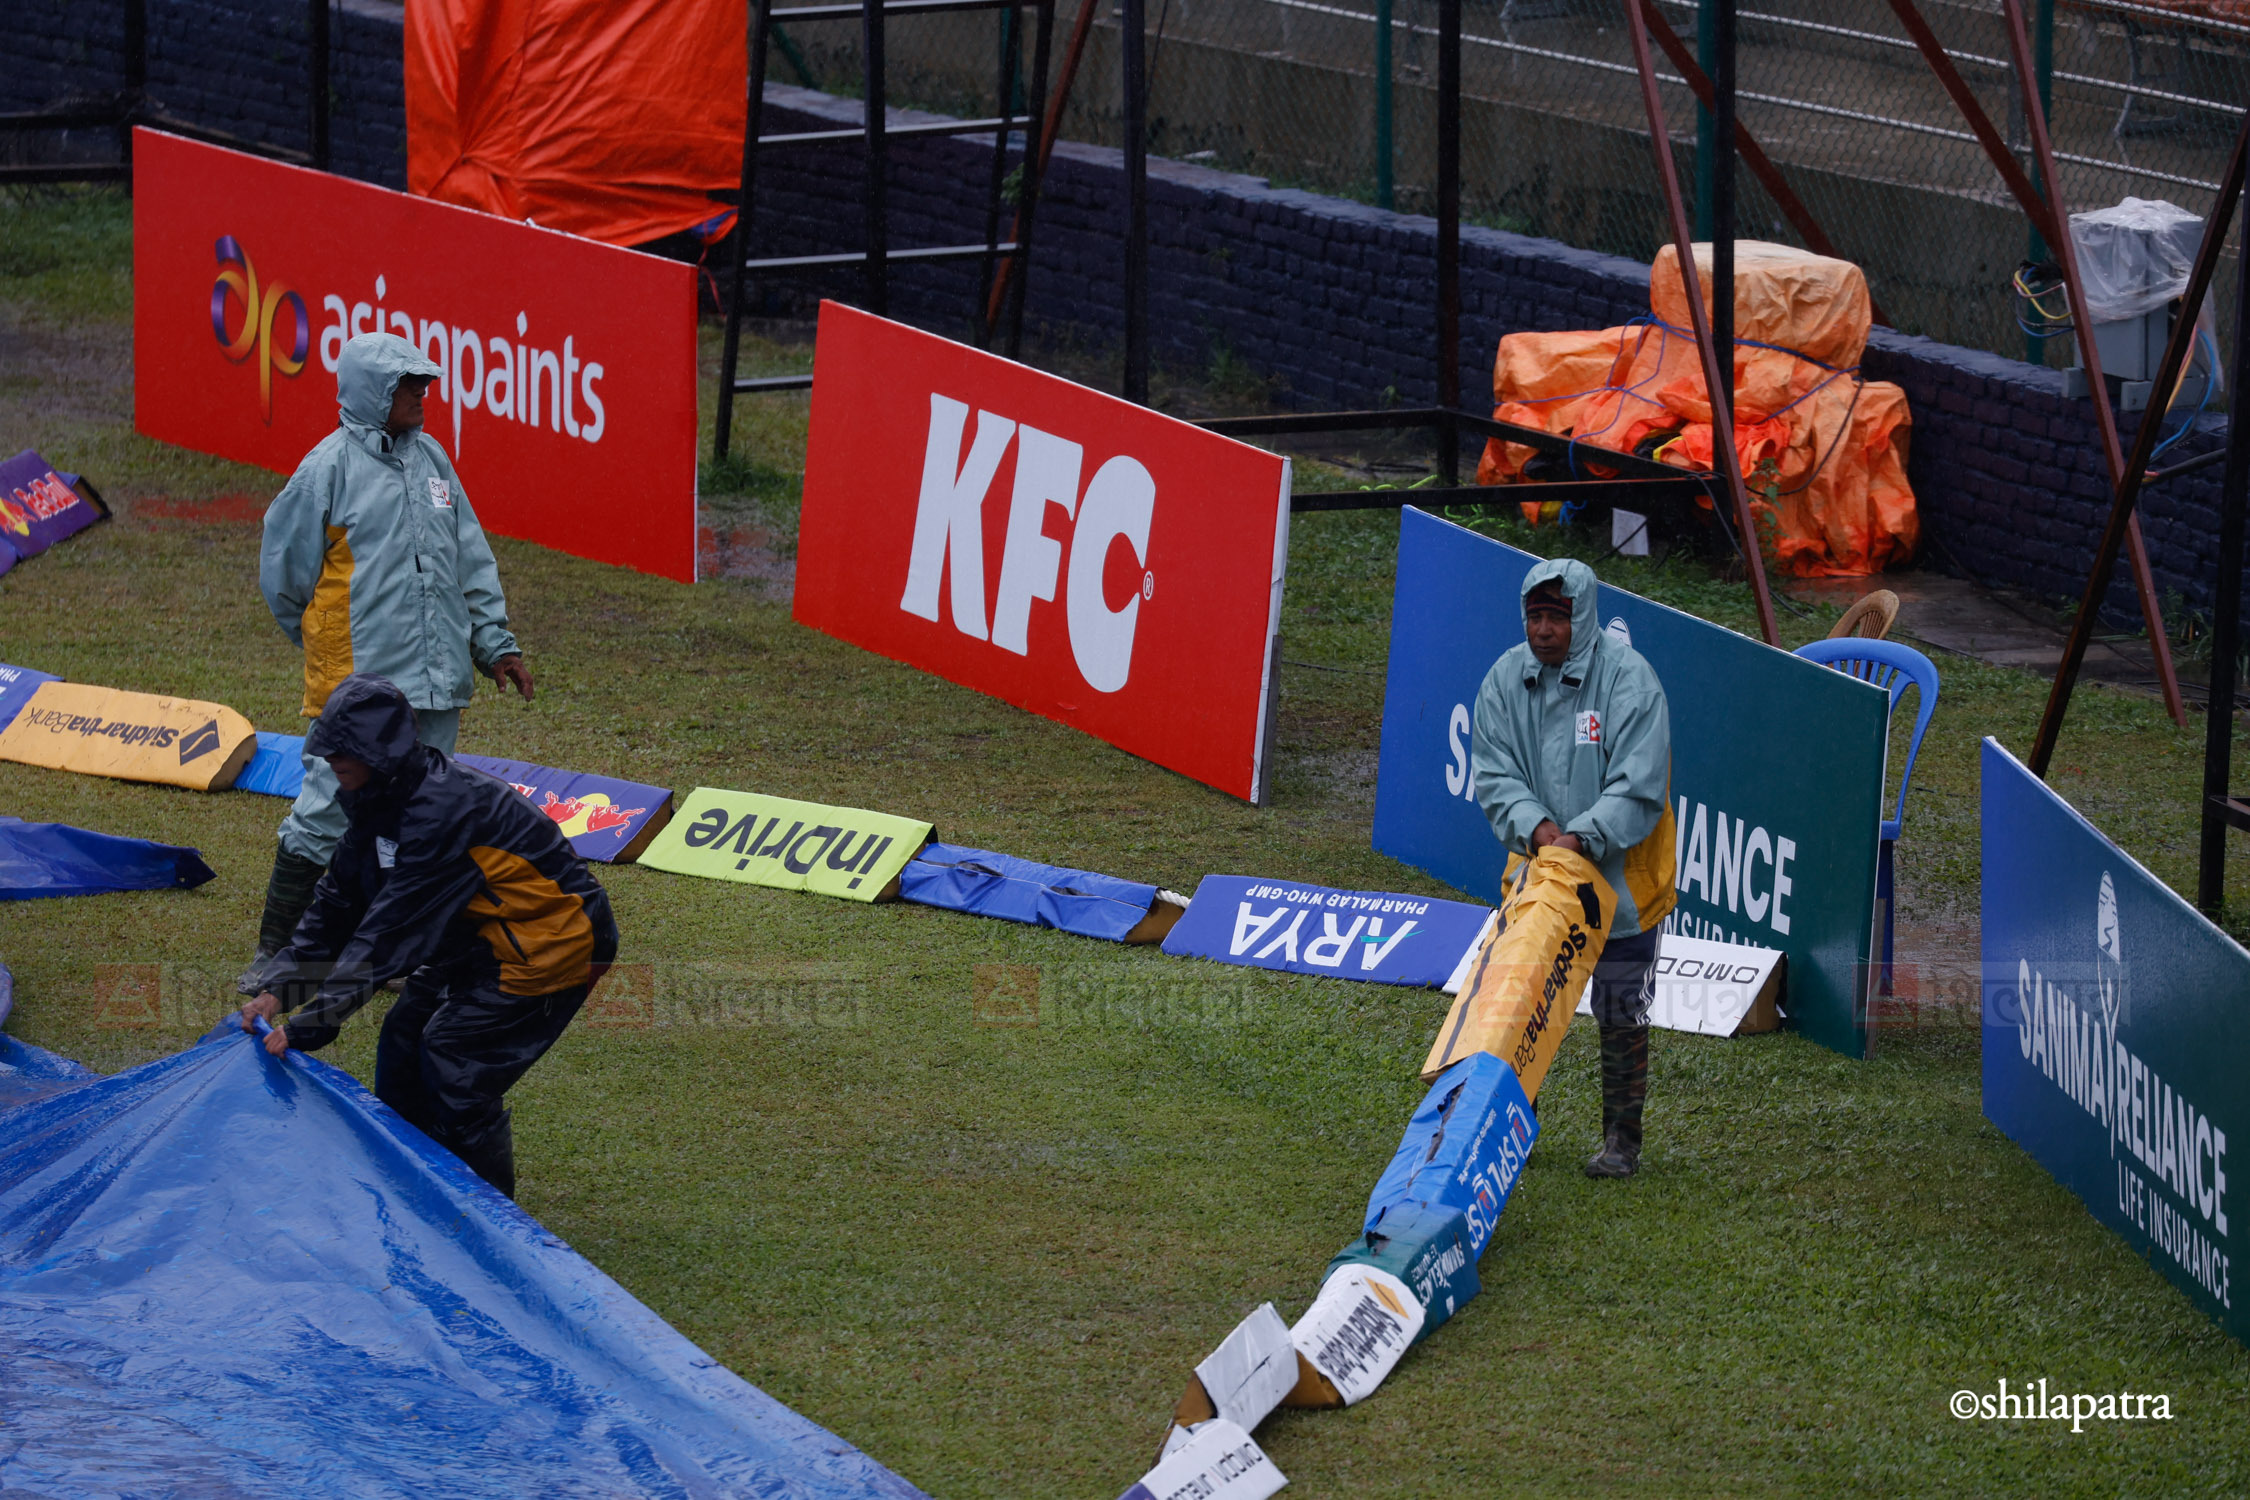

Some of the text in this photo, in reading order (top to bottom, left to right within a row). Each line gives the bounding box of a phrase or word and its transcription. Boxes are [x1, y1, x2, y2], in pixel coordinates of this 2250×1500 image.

[900, 391, 1157, 693] KFC
[684, 808, 894, 889] inDrive
[1245, 884, 1429, 915] PHARMALAB WHO-GMP
[1675, 794, 1797, 936] IANCE
[1229, 901, 1424, 970] ARYA
[1656, 956, 1760, 984] OMOD
[2018, 958, 2228, 1238] SANIMA RELIANCE
[2118, 1159, 2231, 1310] LIFE INSURANCE
